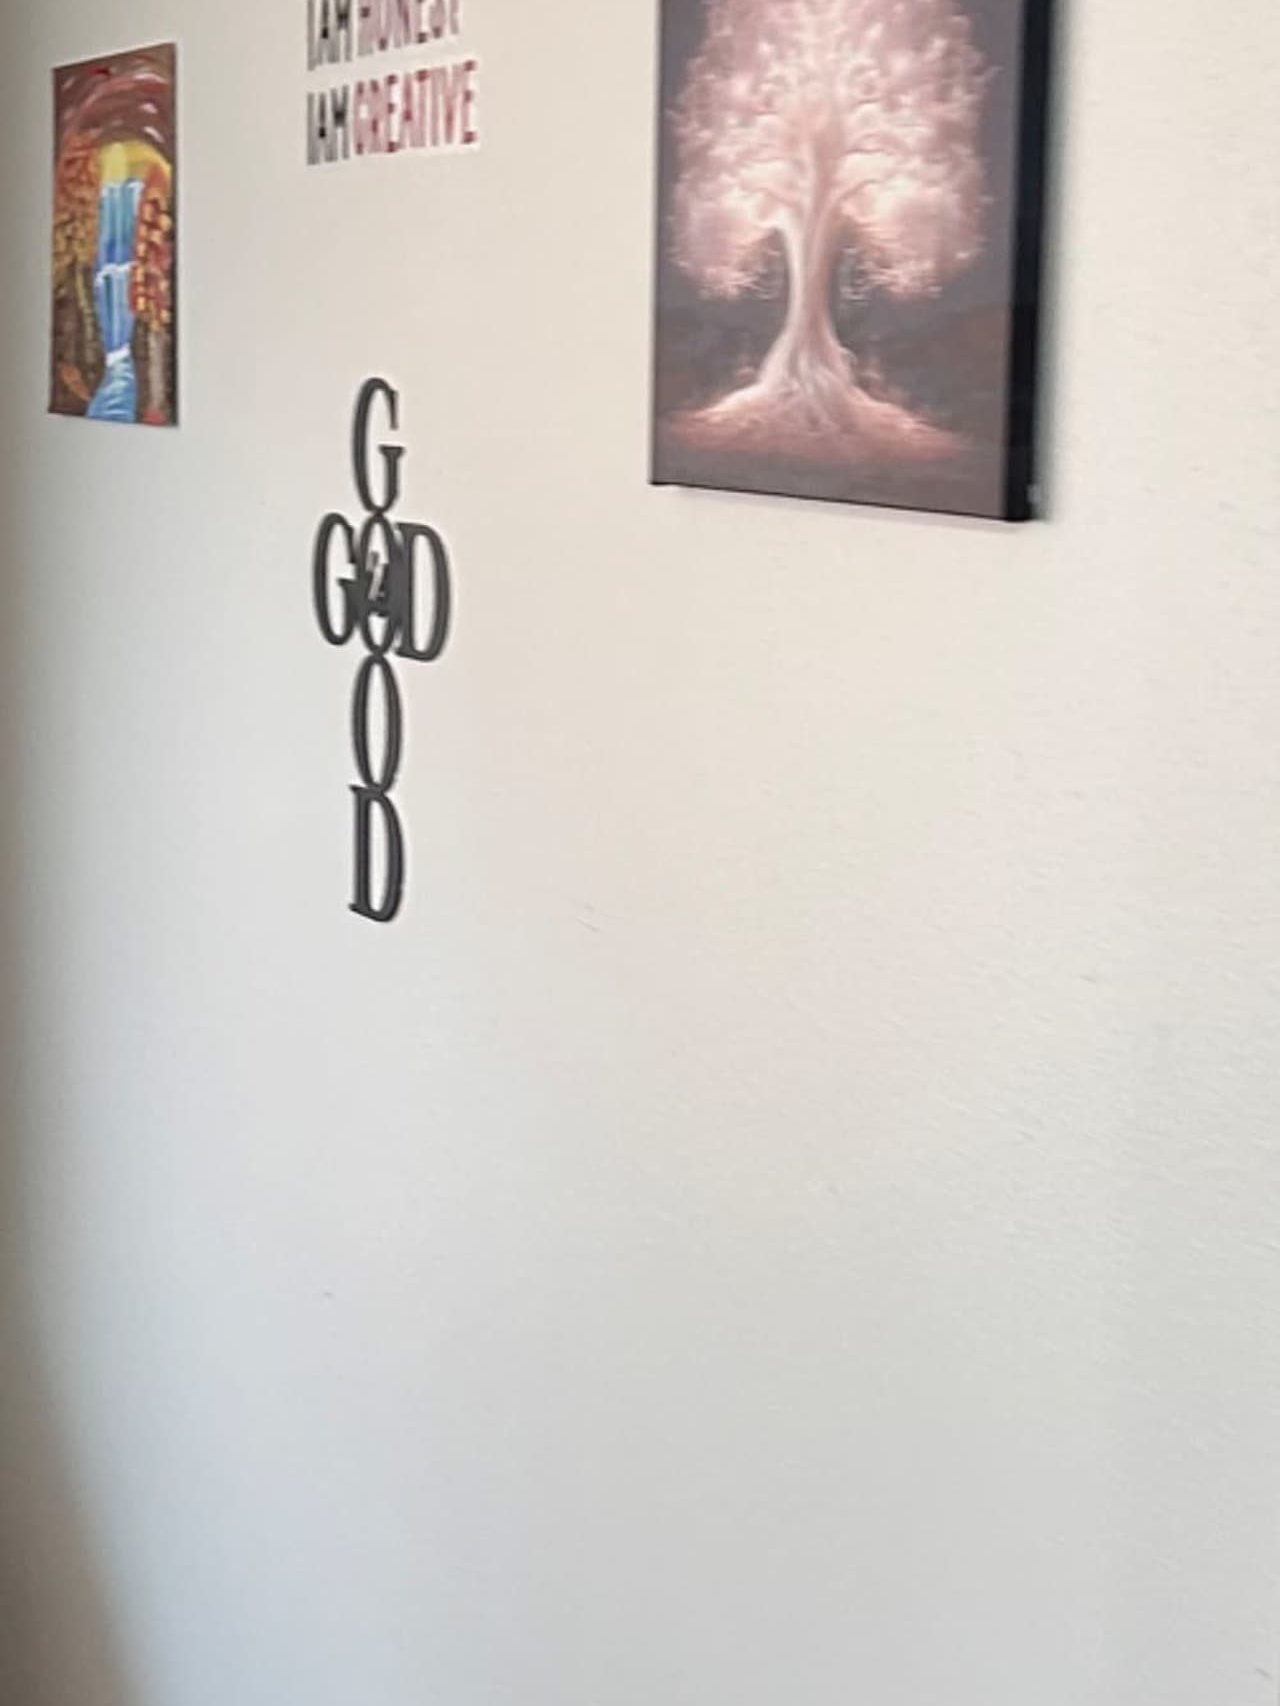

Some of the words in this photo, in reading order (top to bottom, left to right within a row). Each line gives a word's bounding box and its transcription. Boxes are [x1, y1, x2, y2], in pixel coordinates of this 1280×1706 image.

[307, 92, 316, 166] I
[316, 85, 350, 165] AM
[352, 60, 478, 155] CREATIVE
[314, 512, 451, 661] GOD
